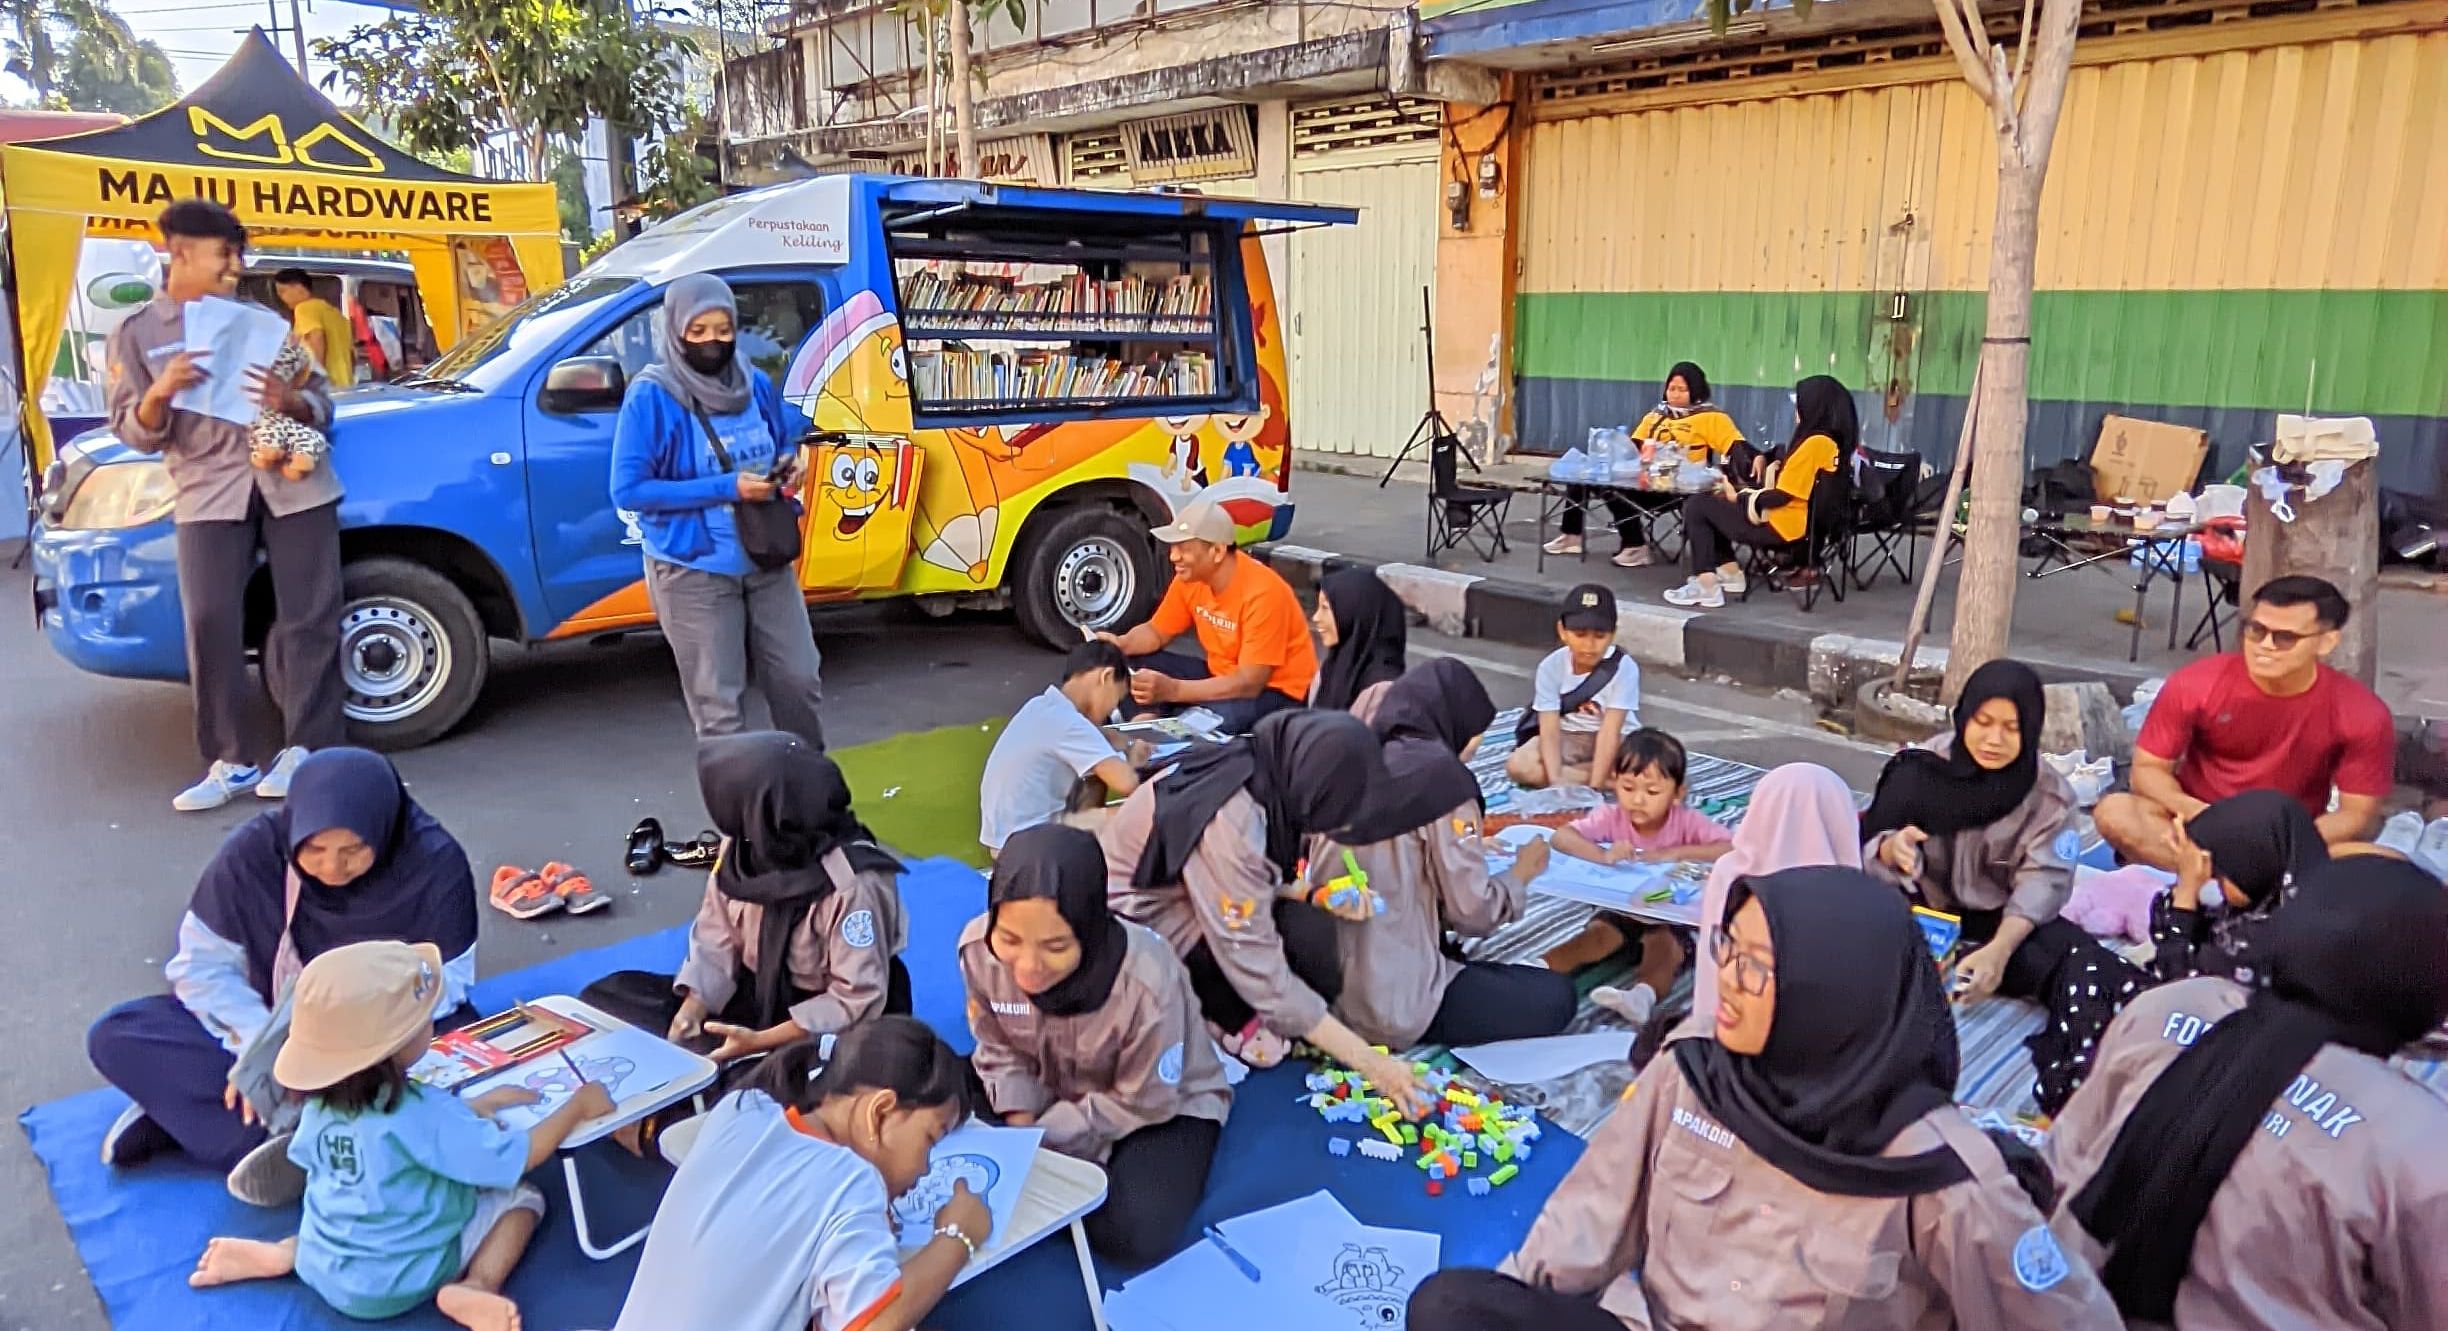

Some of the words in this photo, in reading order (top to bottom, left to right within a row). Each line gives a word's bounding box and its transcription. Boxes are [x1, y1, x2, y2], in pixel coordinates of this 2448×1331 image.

[252, 180, 493, 223] HARDWARE
[748, 217, 830, 233] Perpustakaan
[782, 235, 844, 253] Keliling
